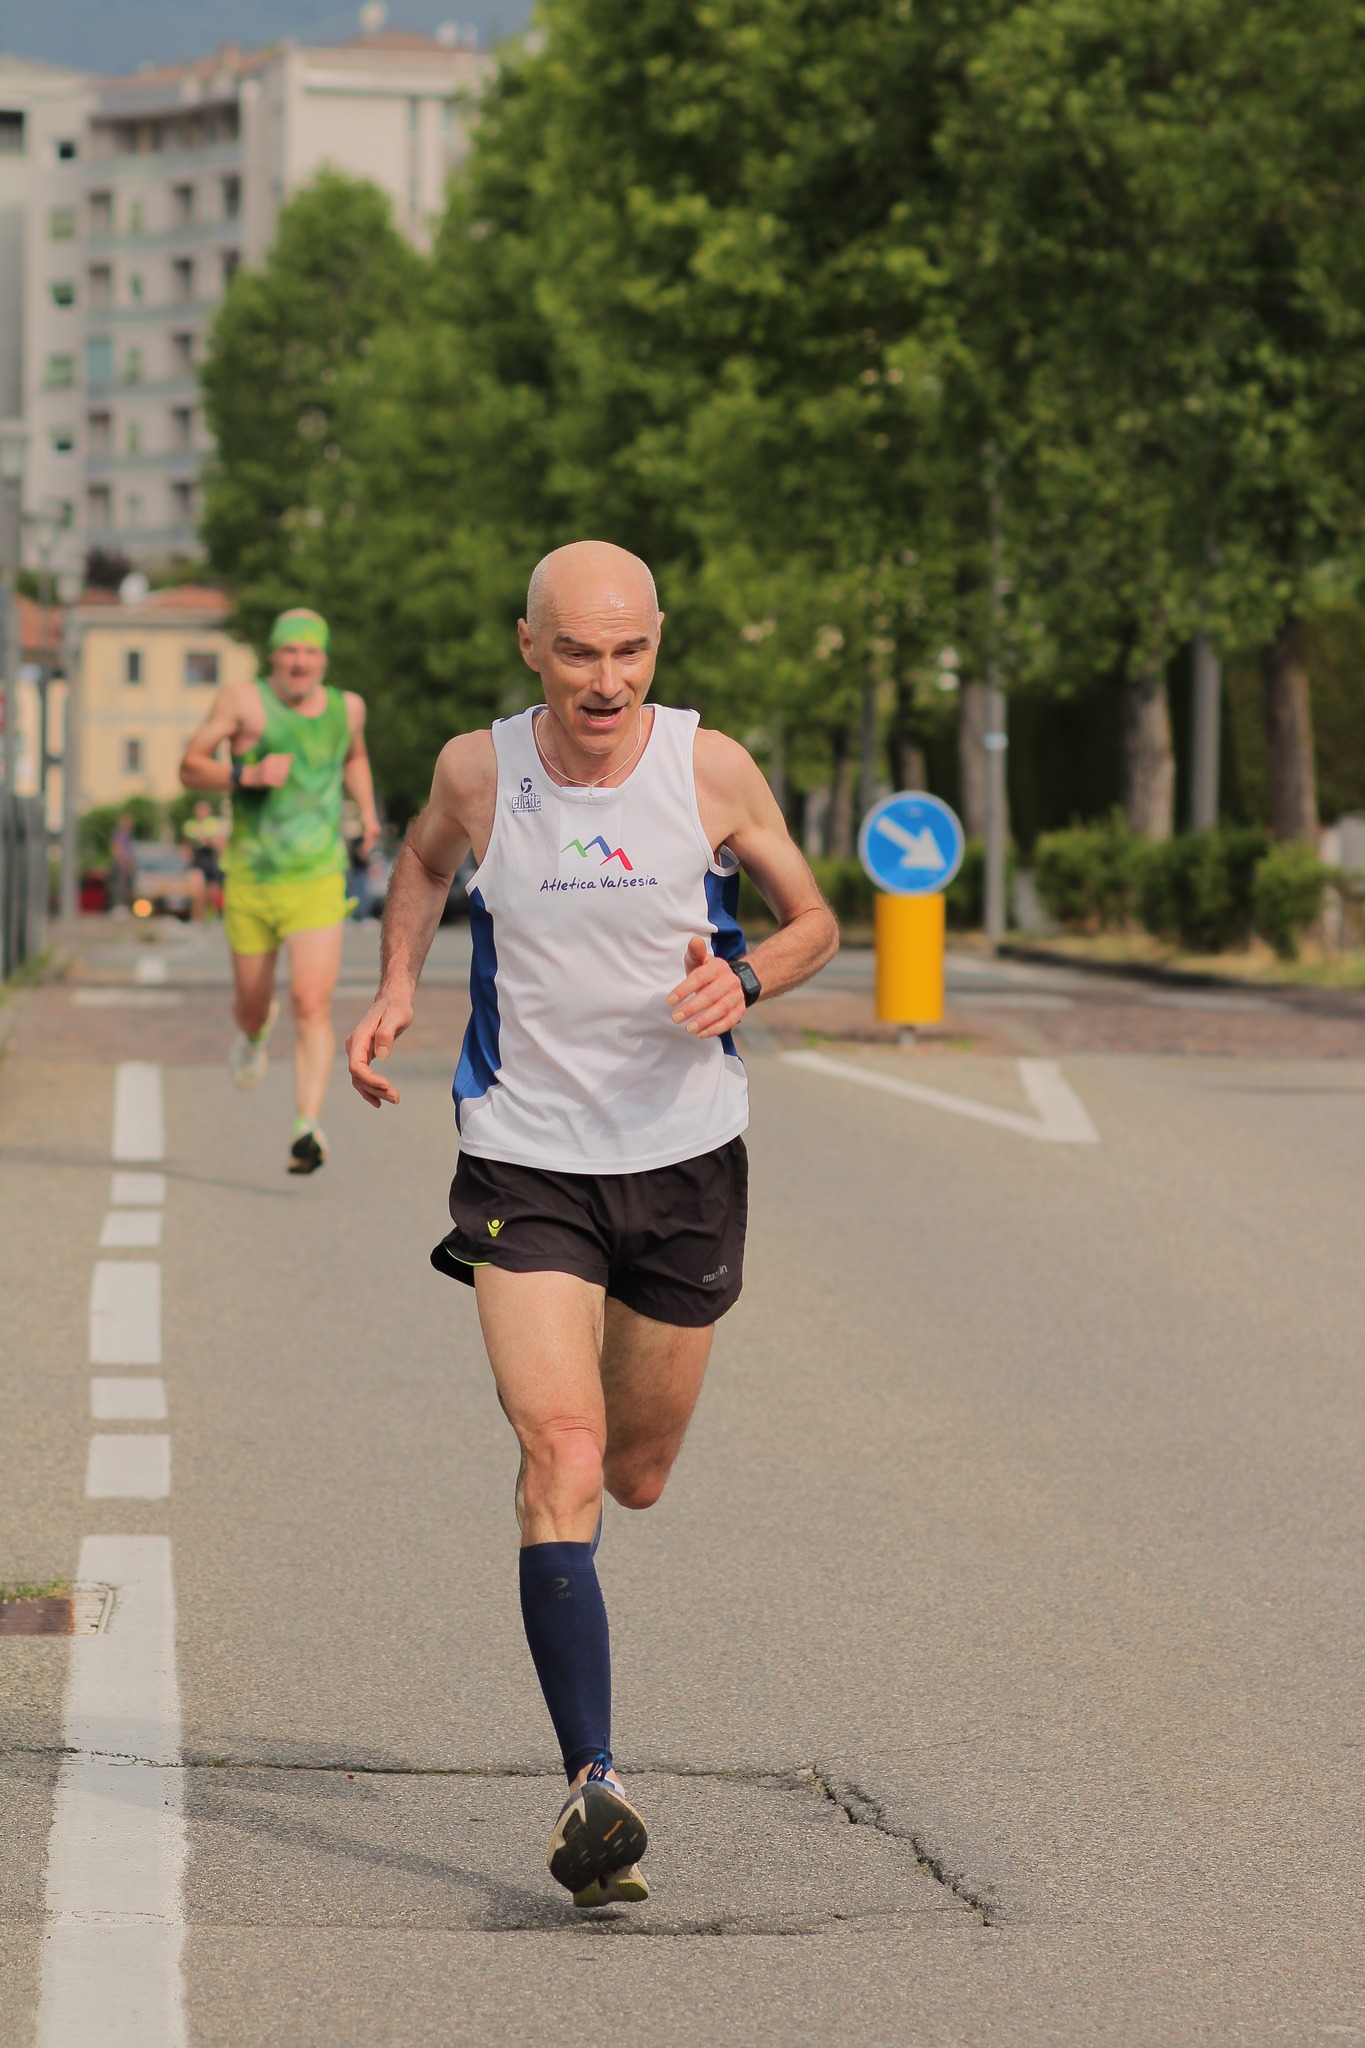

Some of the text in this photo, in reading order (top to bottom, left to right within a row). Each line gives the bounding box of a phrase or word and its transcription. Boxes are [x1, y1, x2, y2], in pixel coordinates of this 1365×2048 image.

[512, 793, 541, 809] elleffe
[539, 874, 657, 891] Atletica Valsesia
